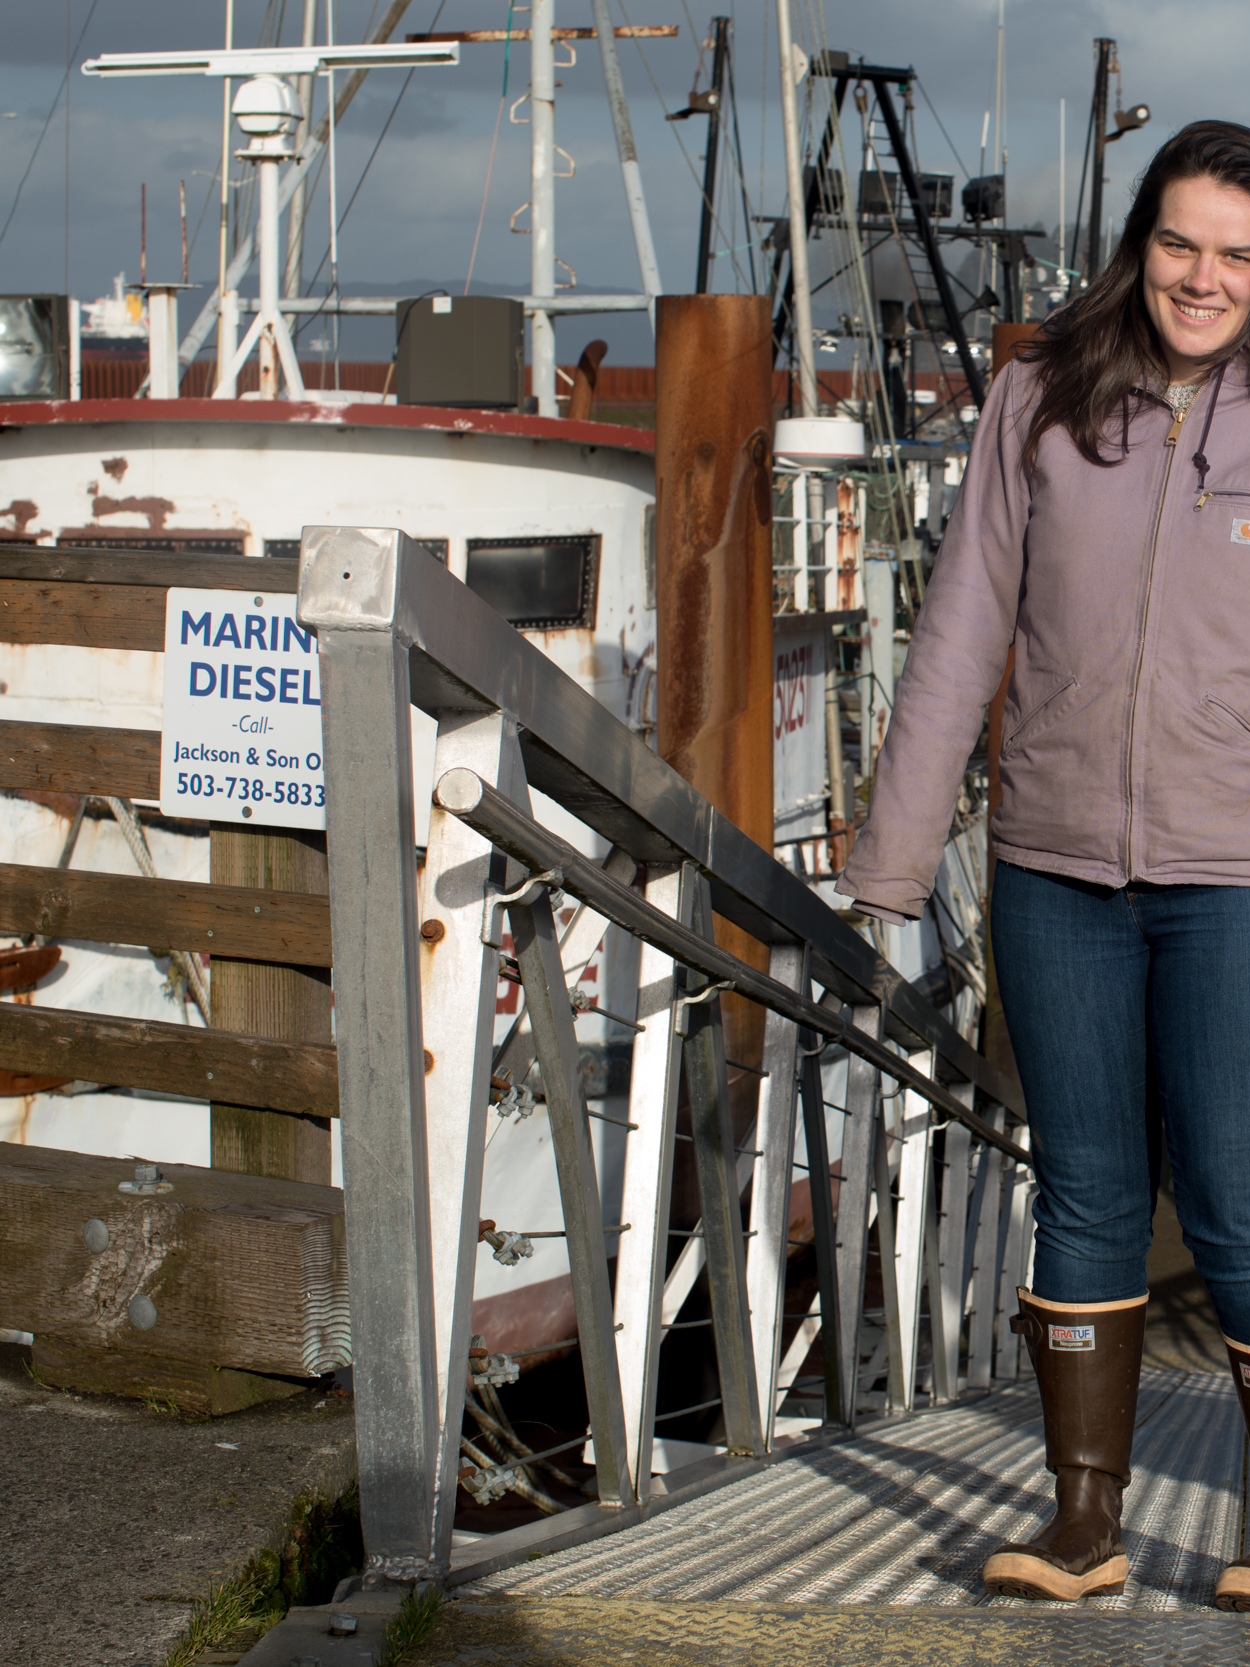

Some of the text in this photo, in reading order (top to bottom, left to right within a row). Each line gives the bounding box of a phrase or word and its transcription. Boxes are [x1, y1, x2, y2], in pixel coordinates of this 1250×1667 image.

[180, 610, 319, 654] MARIN
[189, 661, 321, 706] DIESEL
[232, 715, 274, 734] -Call-
[174, 741, 324, 771] Jackson & Son O
[177, 772, 326, 807] 503-738-5833
[1051, 1328, 1090, 1339] XTRATUF
